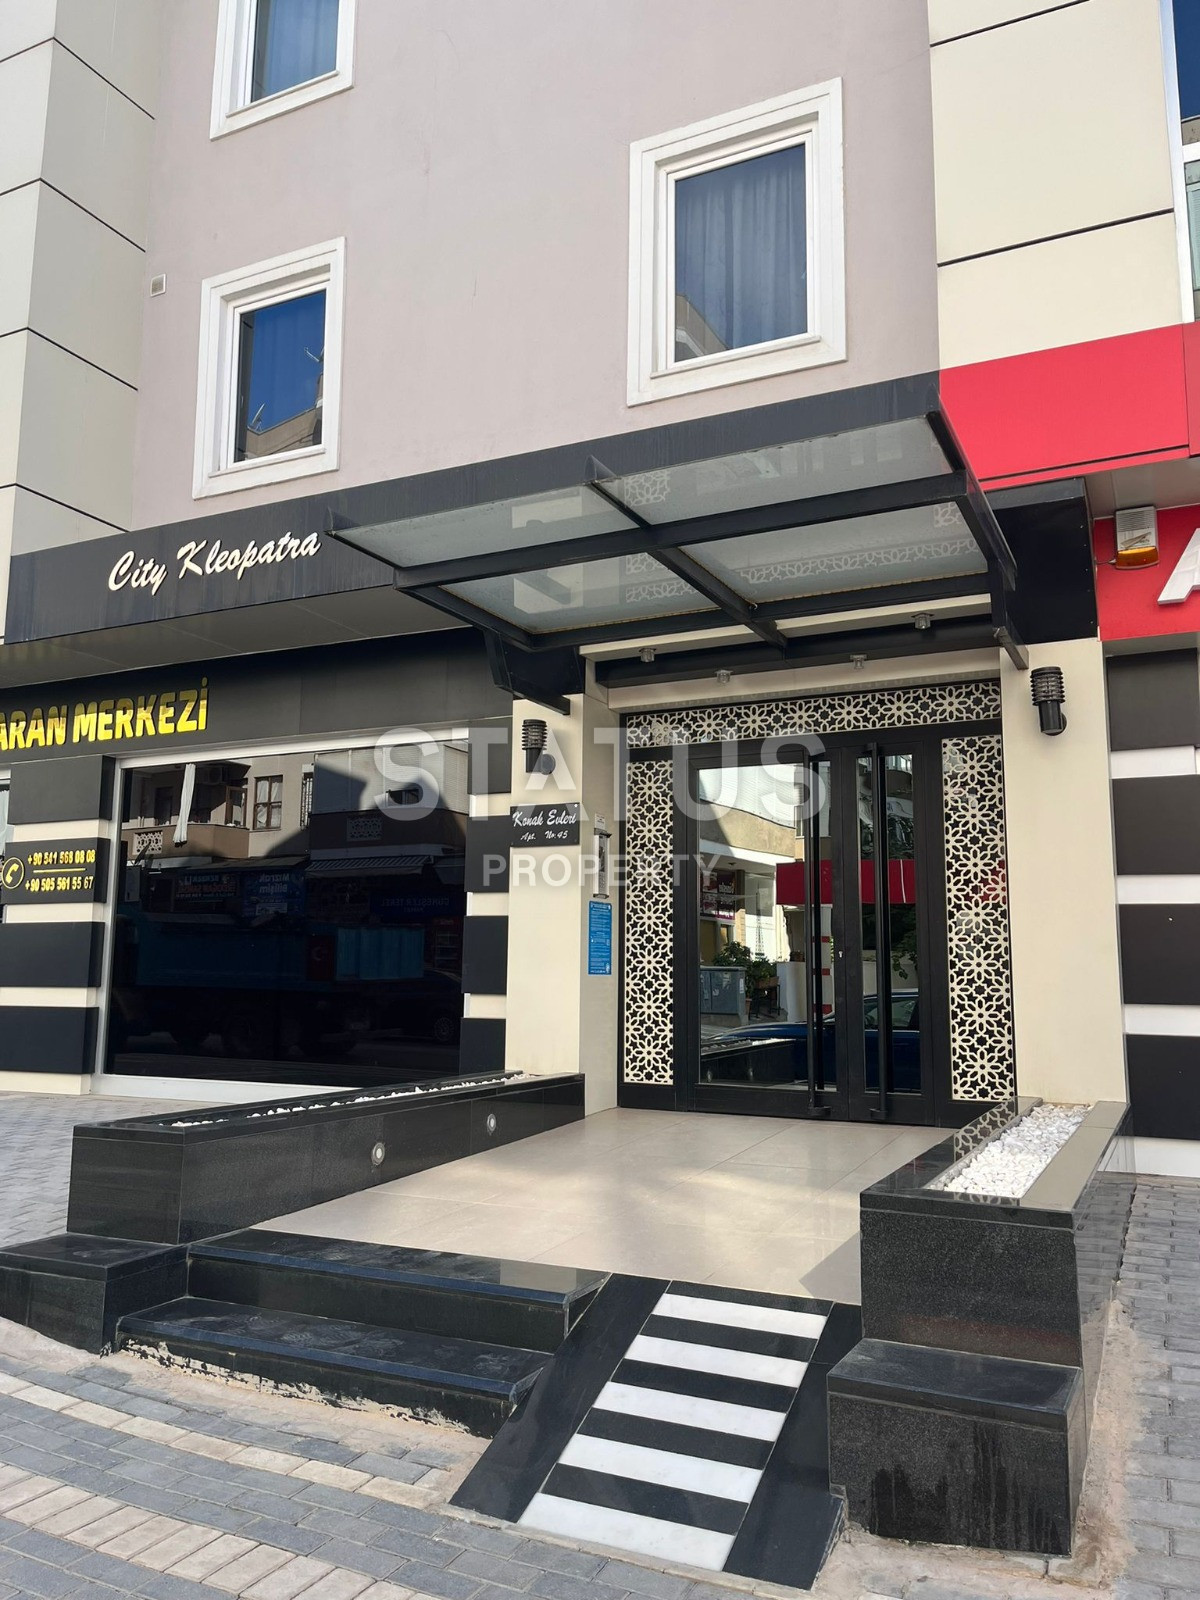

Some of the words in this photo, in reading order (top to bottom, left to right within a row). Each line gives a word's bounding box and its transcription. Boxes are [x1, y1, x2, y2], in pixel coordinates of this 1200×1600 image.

[108, 550, 168, 596] City
[177, 532, 323, 580] Kleopatra
[72, 676, 209, 743] MERKEZİ
[512, 810, 544, 827] Konak
[547, 809, 577, 825] Evleri
[27, 851, 43, 866] +90
[24, 878, 40, 892] +90
[41, 877, 55, 891] 505
[71, 876, 82, 890] 55
[83, 875, 94, 889] 67
